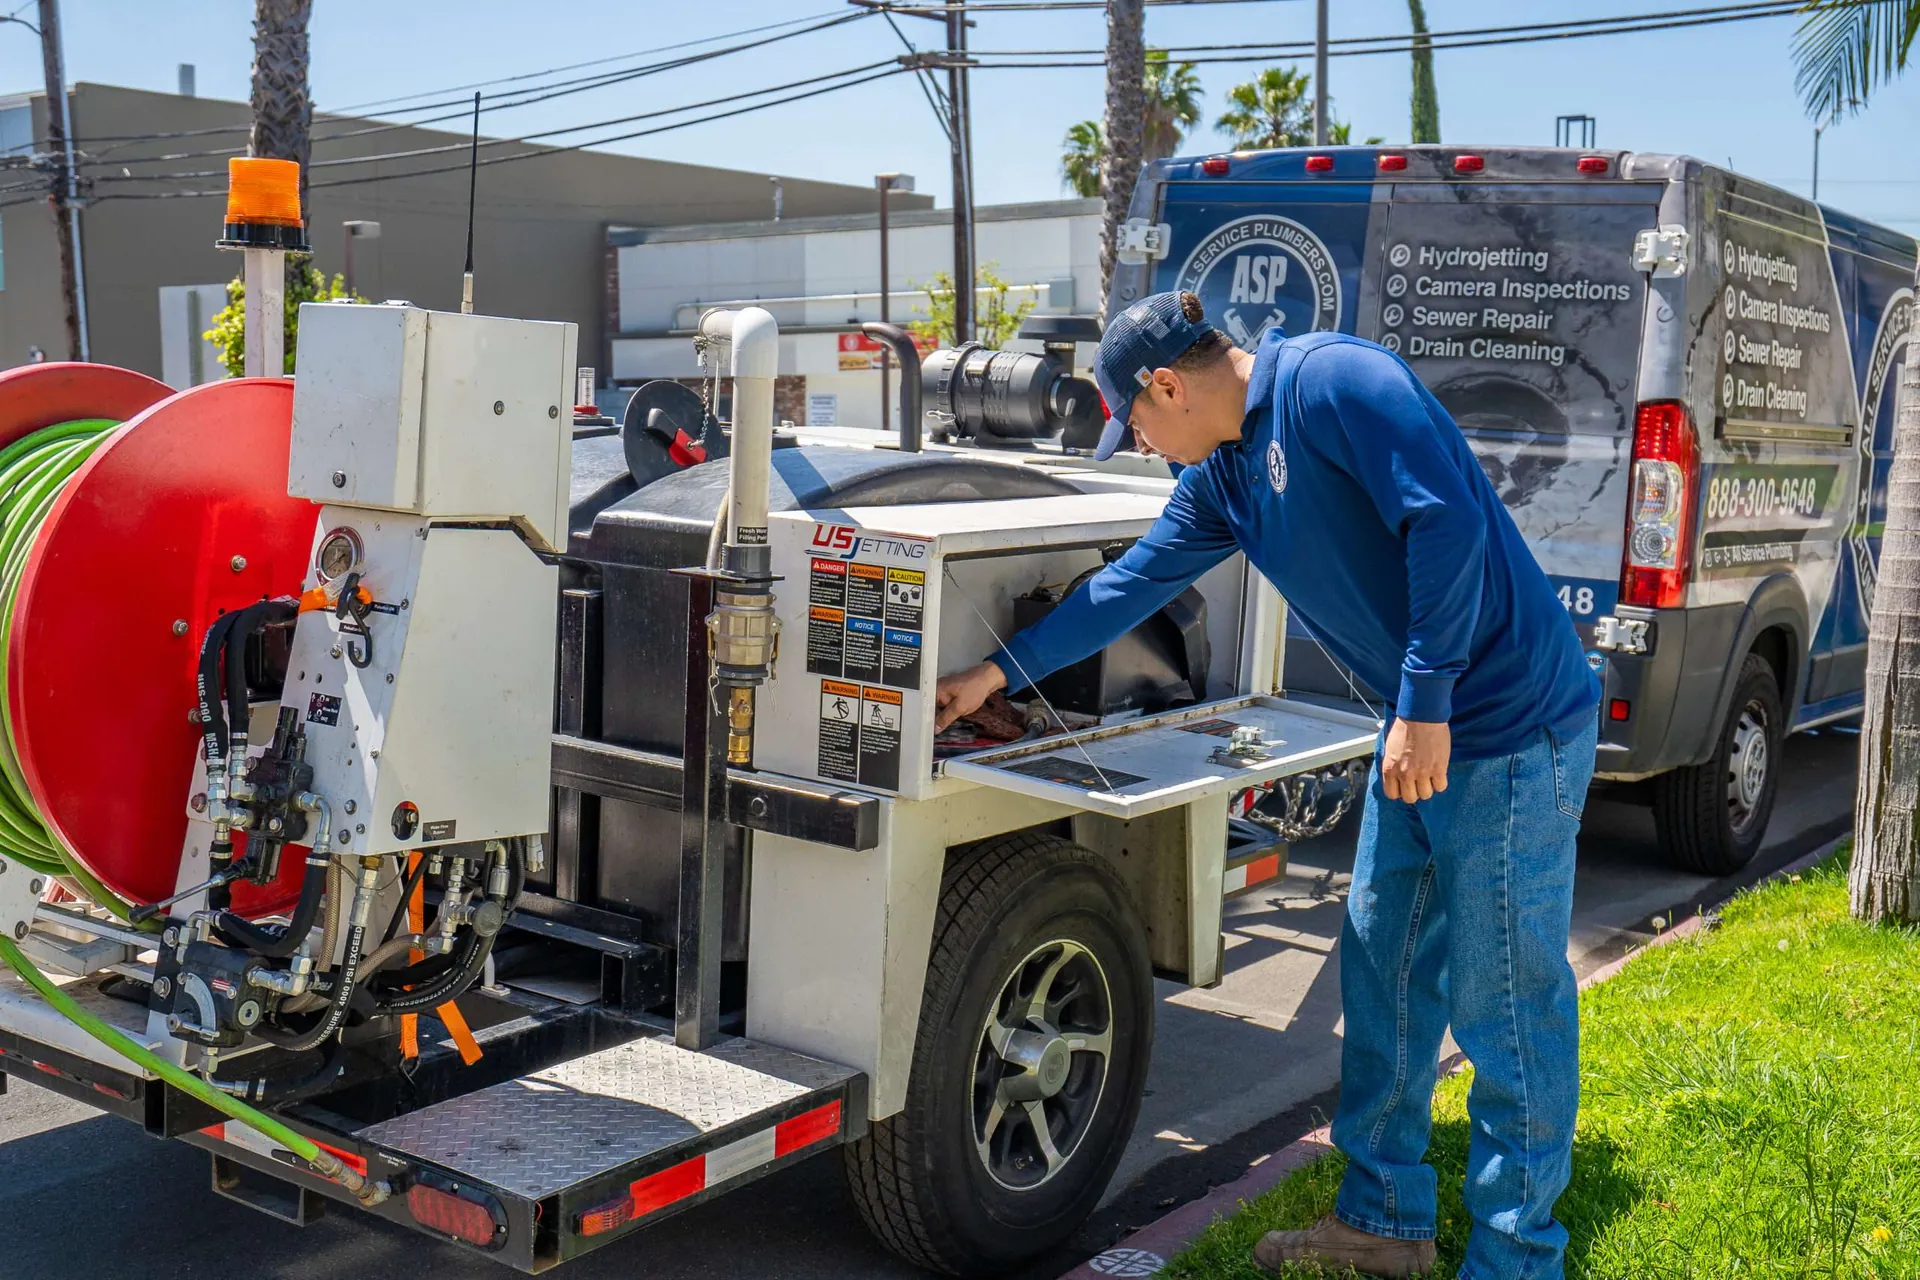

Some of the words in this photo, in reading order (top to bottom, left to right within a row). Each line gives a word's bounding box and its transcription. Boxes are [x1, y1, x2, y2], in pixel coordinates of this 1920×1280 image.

[1193, 225, 1250, 273] SERVICE
[1254, 222, 1336, 312] PLUMBERS.COM
[1419, 246, 1549, 272] Hydrojetting
[1737, 245, 1798, 291] Hydrojetting
[1229, 254, 1288, 304] ASP
[1415, 276, 1496, 298] Camera
[1502, 278, 1631, 303] Inspections
[1412, 306, 1477, 328] Sewer
[1482, 308, 1553, 333] Repair
[1739, 289, 1777, 322] Camera
[1779, 298, 1830, 333] Inspections
[1409, 336, 1464, 358] Drain
[1470, 338, 1566, 366] Cleaning
[1738, 334, 1771, 364] Sewer
[1772, 339, 1802, 374] Repair
[1861, 398, 1878, 458] ALL
[1871, 307, 1904, 394] SERVICE
[1737, 378, 1764, 408] Drain
[1766, 381, 1807, 418] Cleaning
[1707, 477, 1816, 519] 888-300-9648
[1732, 545, 1742, 563] All
[1741, 544, 1766, 562] Service
[1766, 542, 1793, 561] Plumbing
[820, 564, 845, 573] DANGER
[855, 568, 884, 577] WARNING
[896, 571, 923, 582] CAUTION
[816, 611, 843, 620] WARNING
[854, 621, 874, 631] NOTICE
[893, 633, 913, 643] NOTICE
[831, 686, 858, 695] WARNING
[872, 693, 900, 702] WARNING
[350, 925, 363, 965] EXCEED
[346, 966, 355, 984] PSI
[339, 985, 351, 1007] 4000
